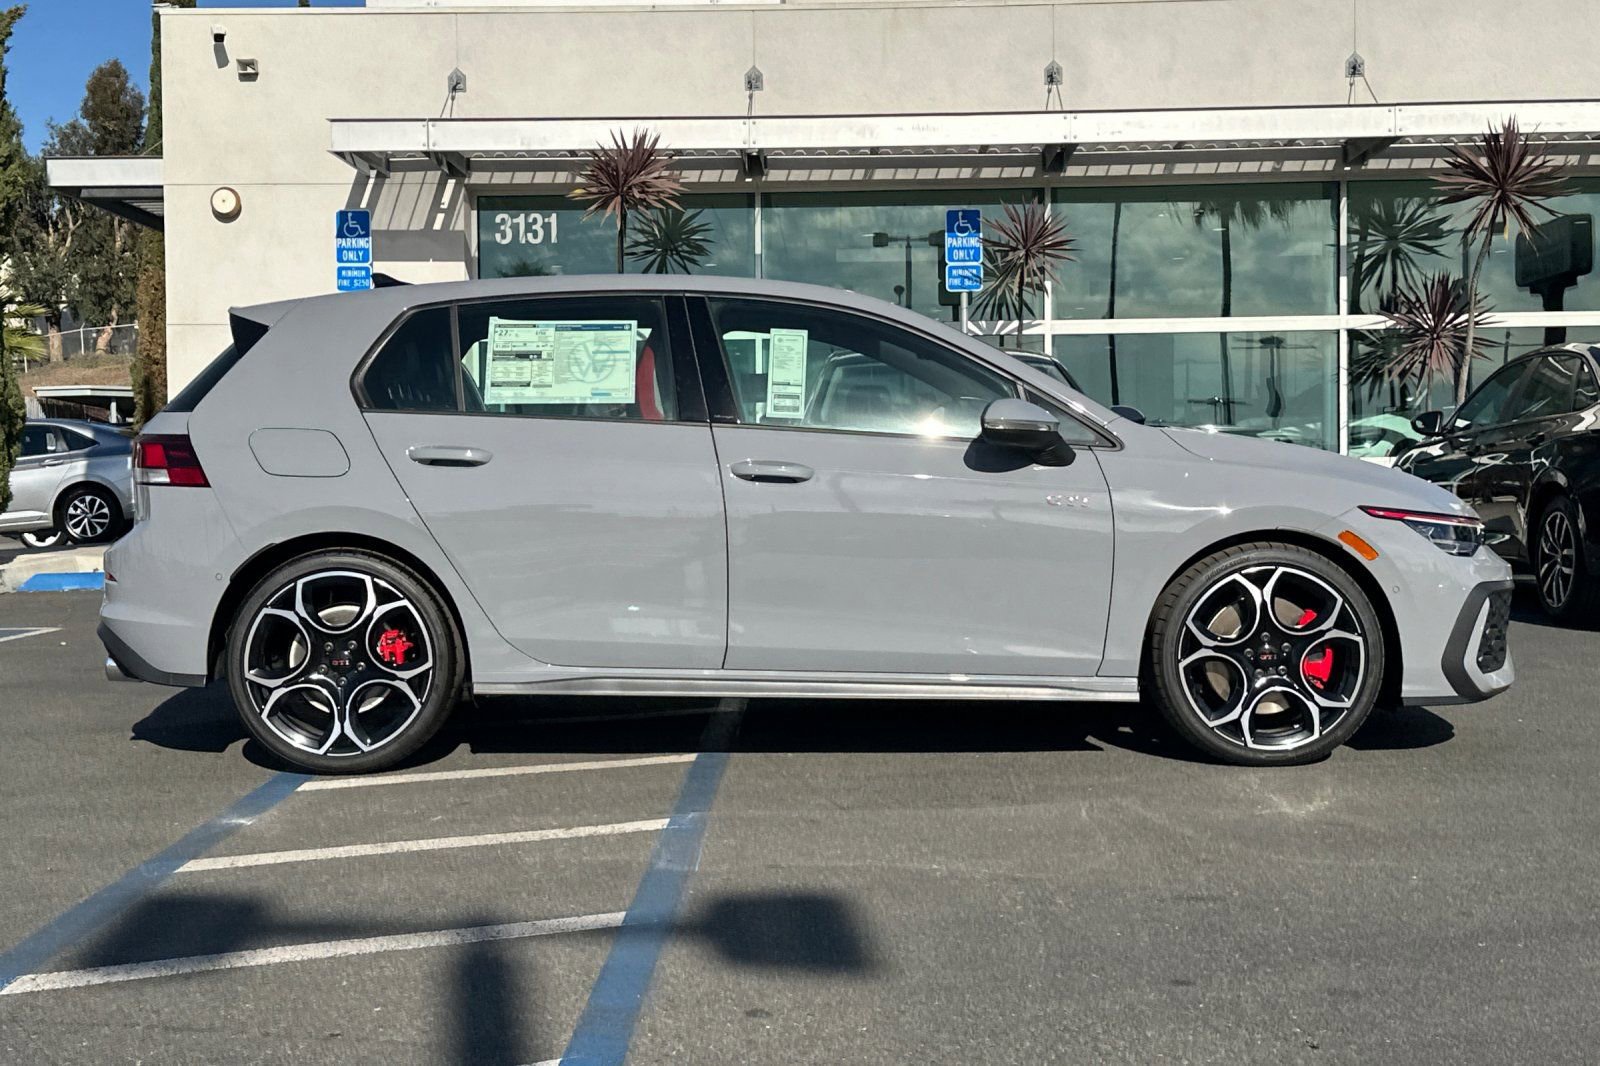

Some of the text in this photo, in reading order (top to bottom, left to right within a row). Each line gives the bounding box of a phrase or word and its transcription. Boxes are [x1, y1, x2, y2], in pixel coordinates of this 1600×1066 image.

[494, 213, 558, 244] 3131
[336, 238, 369, 248] PARKING
[947, 237, 981, 248] PARKING
[342, 250, 364, 261] ONLY
[953, 249, 975, 260] ONLY
[341, 269, 366, 277] MINIMUM
[951, 268, 977, 276] MINIMM
[353, 278, 369, 287] $250
[948, 277, 962, 286] FINE
